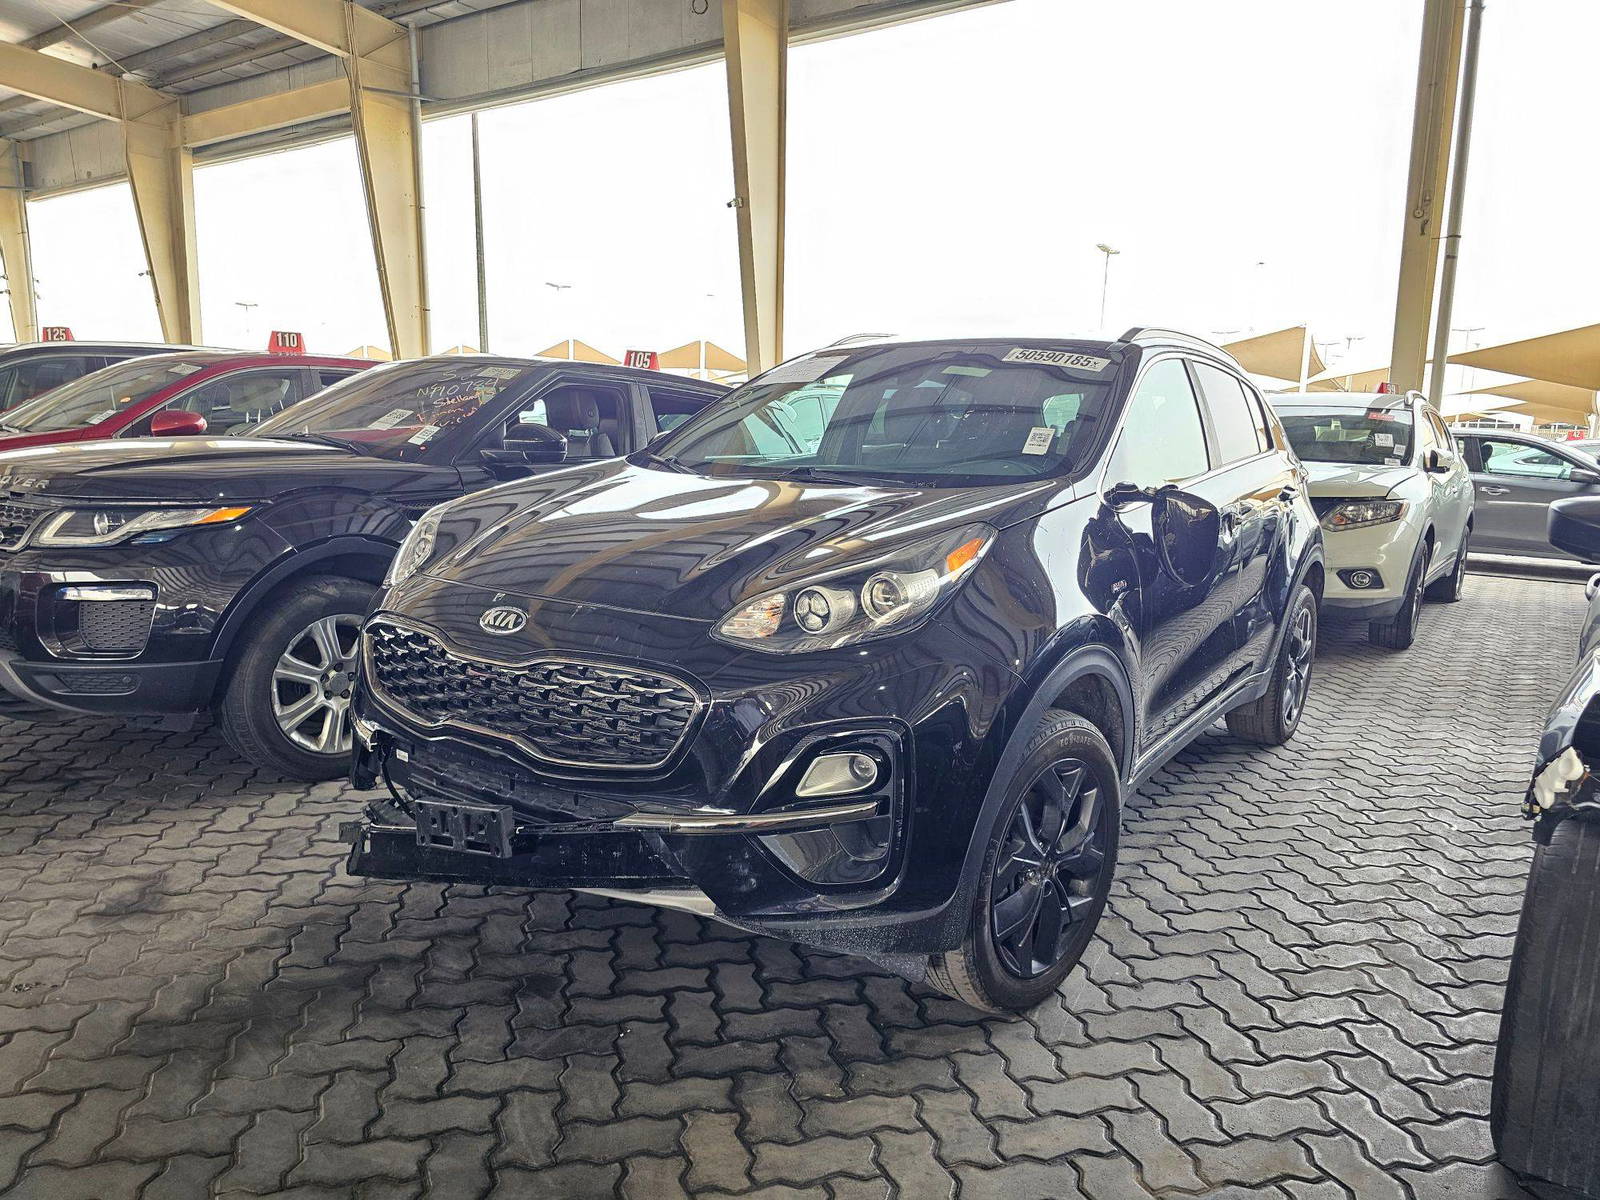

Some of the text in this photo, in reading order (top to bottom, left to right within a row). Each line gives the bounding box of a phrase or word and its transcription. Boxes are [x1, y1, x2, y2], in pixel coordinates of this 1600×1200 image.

[46, 328, 66, 341] 125
[276, 332, 298, 347] 110
[630, 351, 651, 369] 105
[484, 611, 518, 629] KIA
